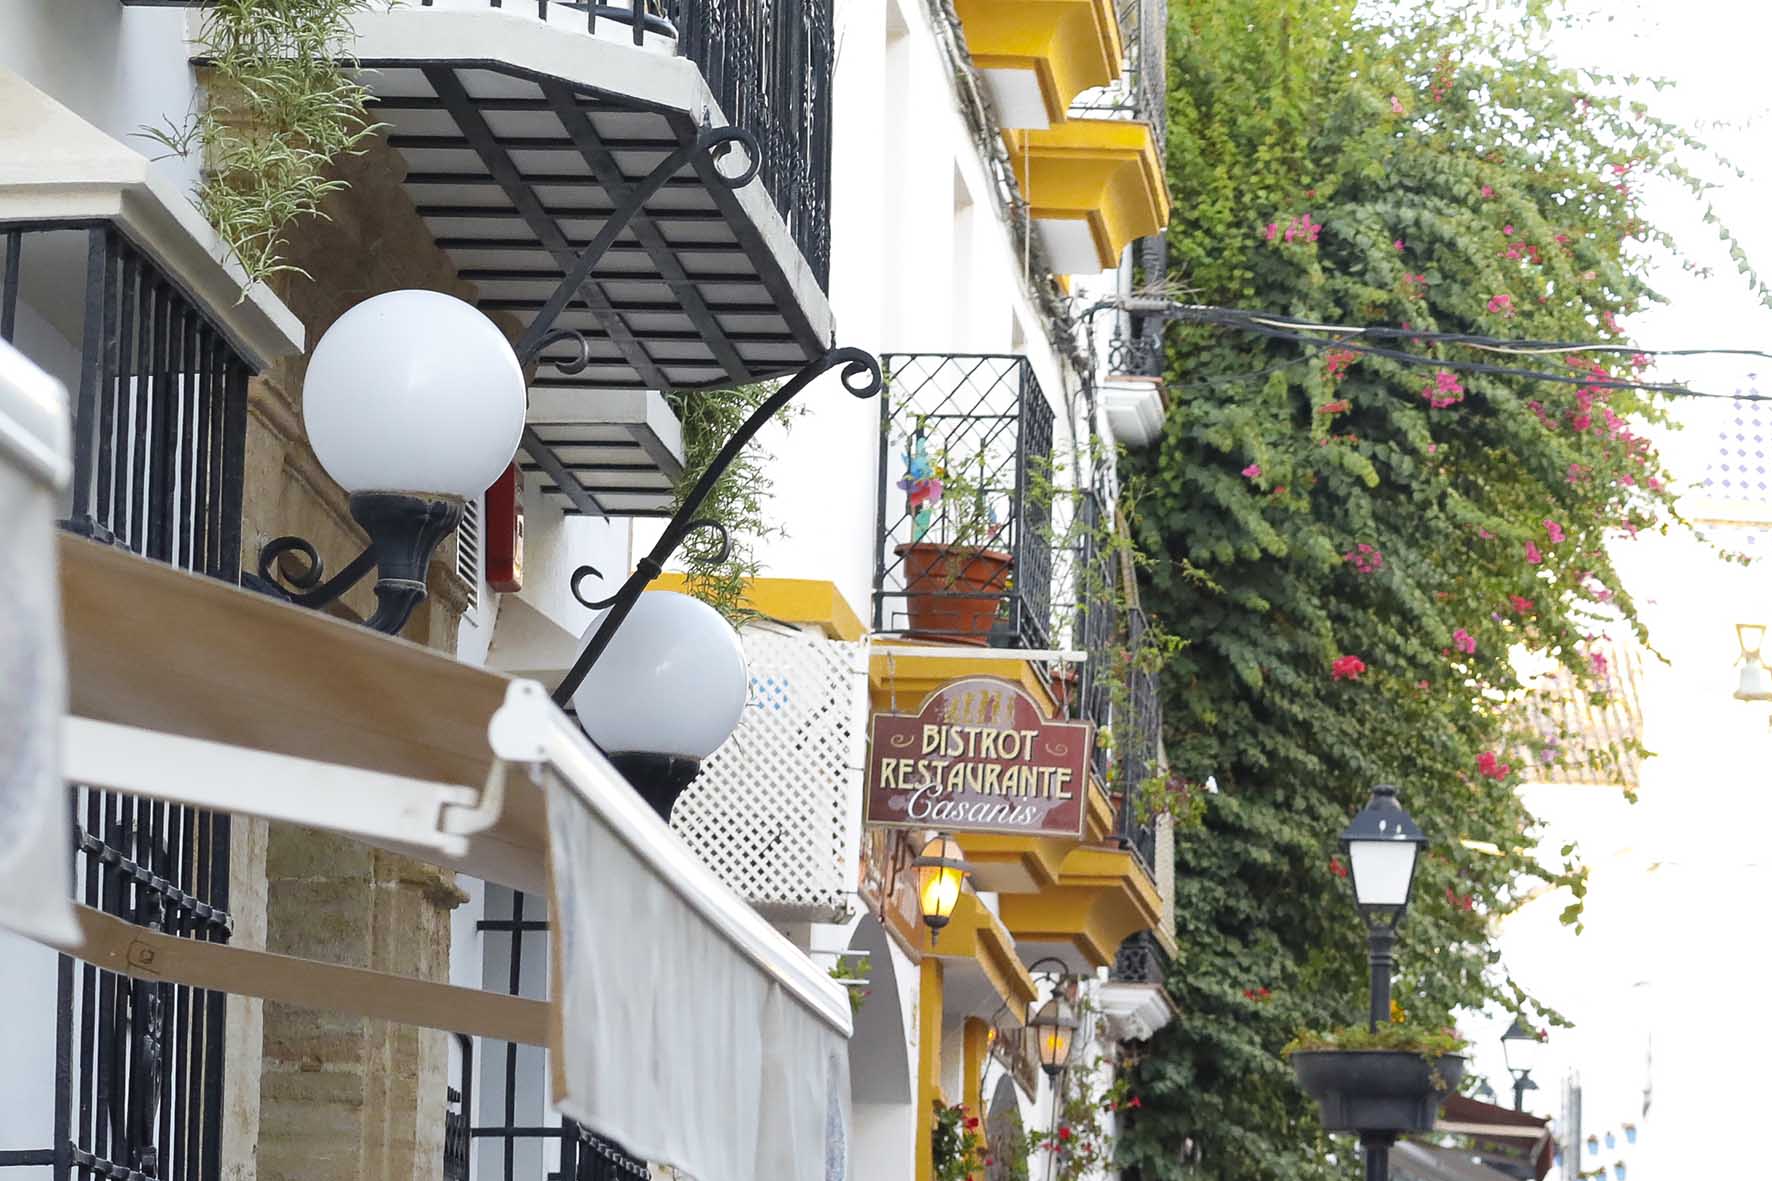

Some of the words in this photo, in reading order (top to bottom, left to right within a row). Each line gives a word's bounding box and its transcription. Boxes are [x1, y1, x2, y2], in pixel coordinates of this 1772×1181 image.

[922, 724, 1039, 761] BISTROT
[879, 758, 1072, 799] RESTAURANTE
[908, 783, 1037, 825] Casanis
